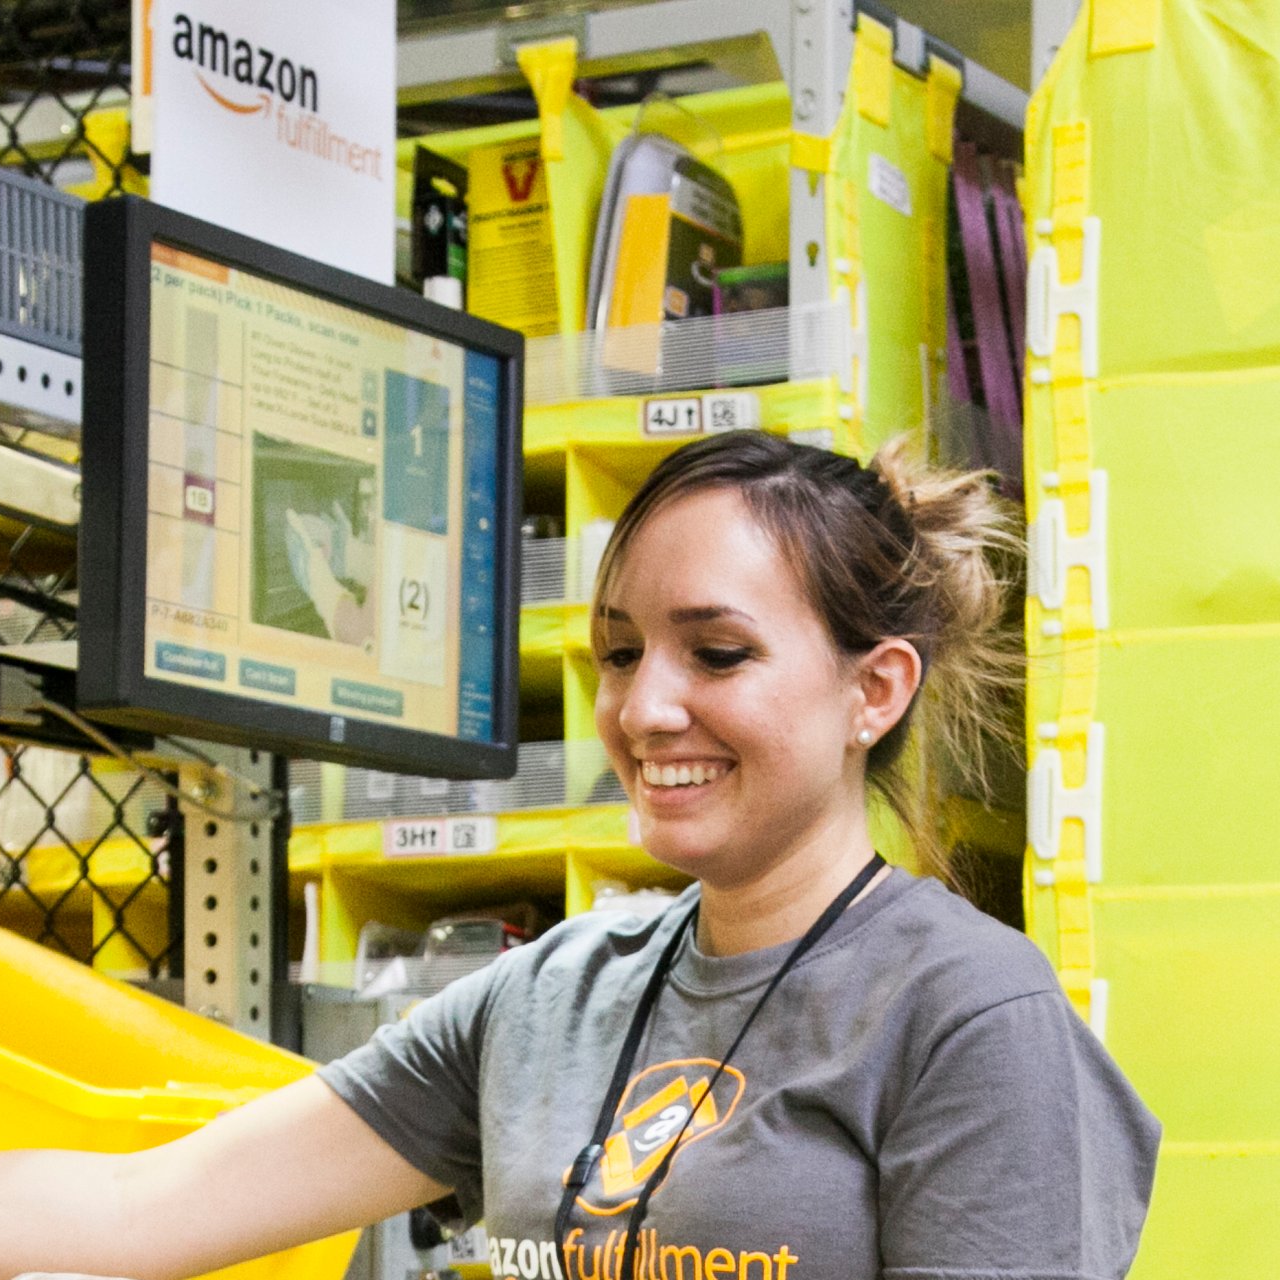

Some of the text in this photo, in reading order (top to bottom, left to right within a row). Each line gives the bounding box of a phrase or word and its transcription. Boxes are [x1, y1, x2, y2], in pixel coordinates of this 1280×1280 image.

[173, 13, 318, 112] amazon
[276, 102, 382, 181] fulfillment
[651, 400, 678, 420] 4J
[409, 426, 423, 458] 1
[398, 577, 431, 620] (2)
[396, 827, 425, 847] 3H
